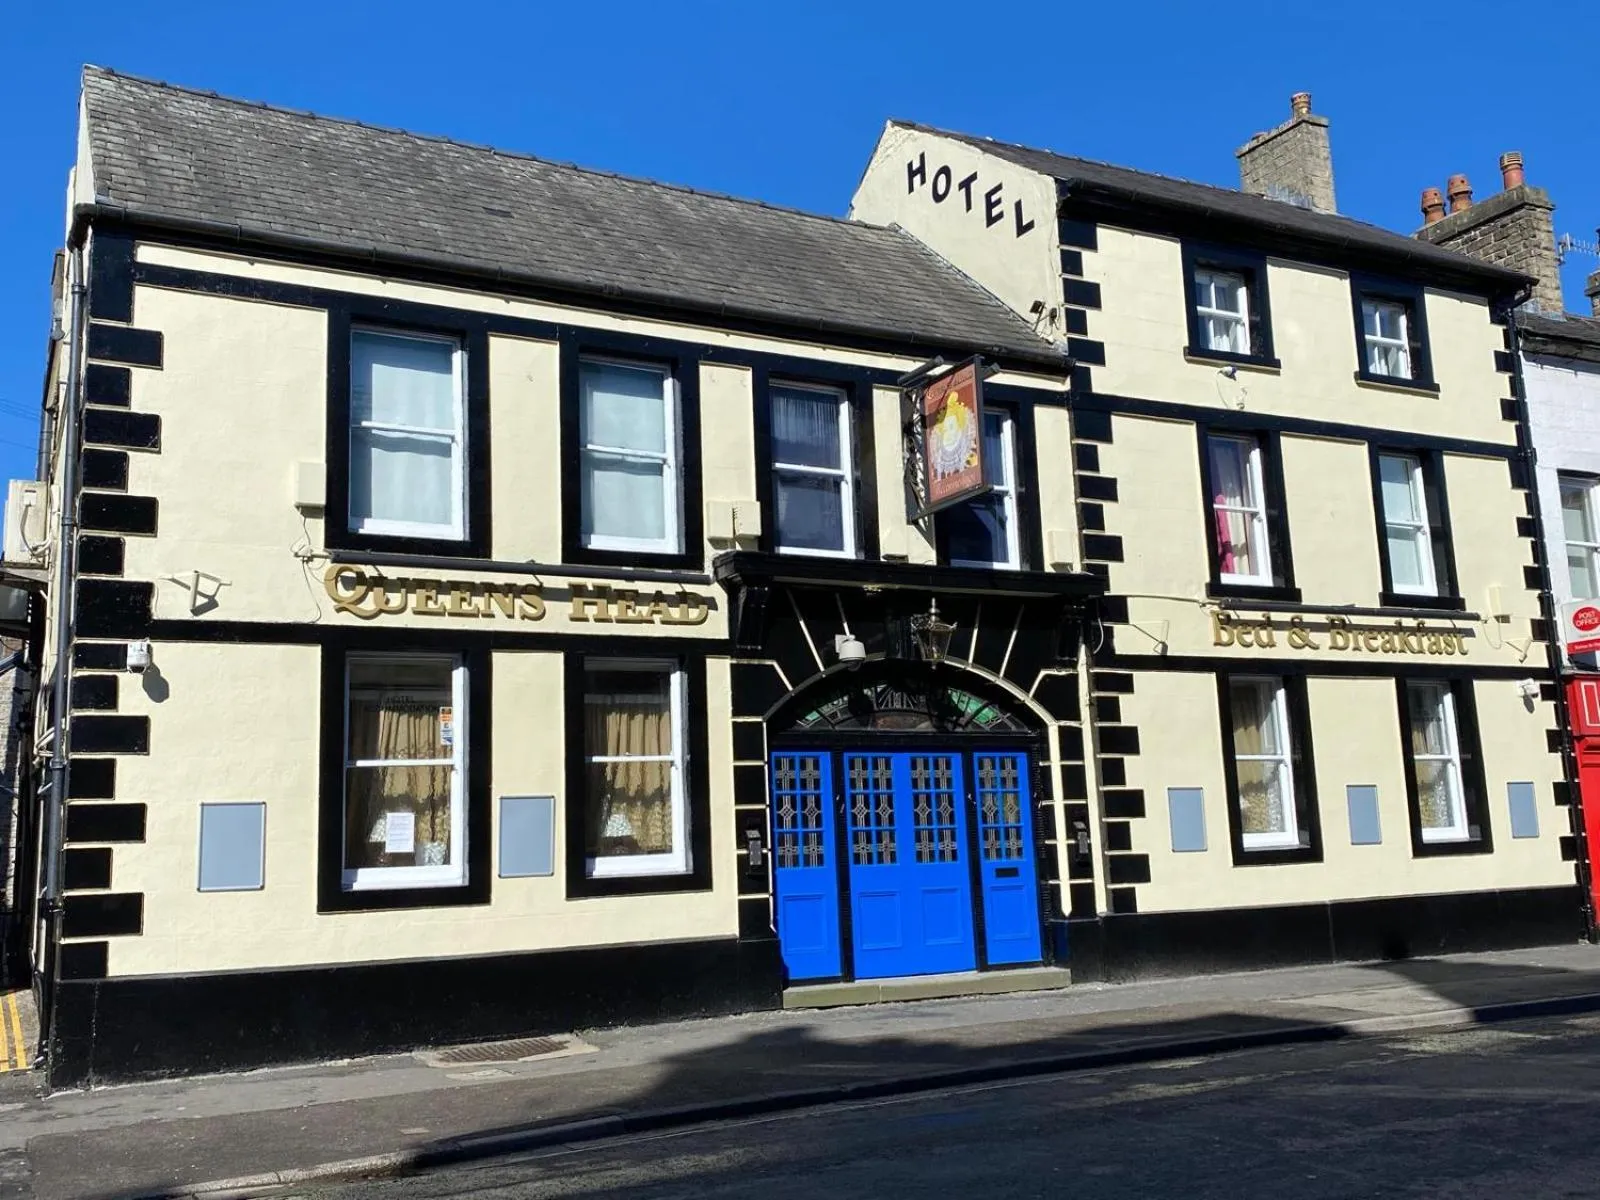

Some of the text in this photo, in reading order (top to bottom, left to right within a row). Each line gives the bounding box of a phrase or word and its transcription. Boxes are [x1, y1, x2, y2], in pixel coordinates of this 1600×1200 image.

[907, 151, 1035, 239] HOTEL
[323, 563, 709, 626] QUEENS HEAD
[1578, 610, 1597, 621] POST
[1210, 609, 1469, 656] Bed & Breakfast
[1575, 617, 1599, 627] OFFICE
